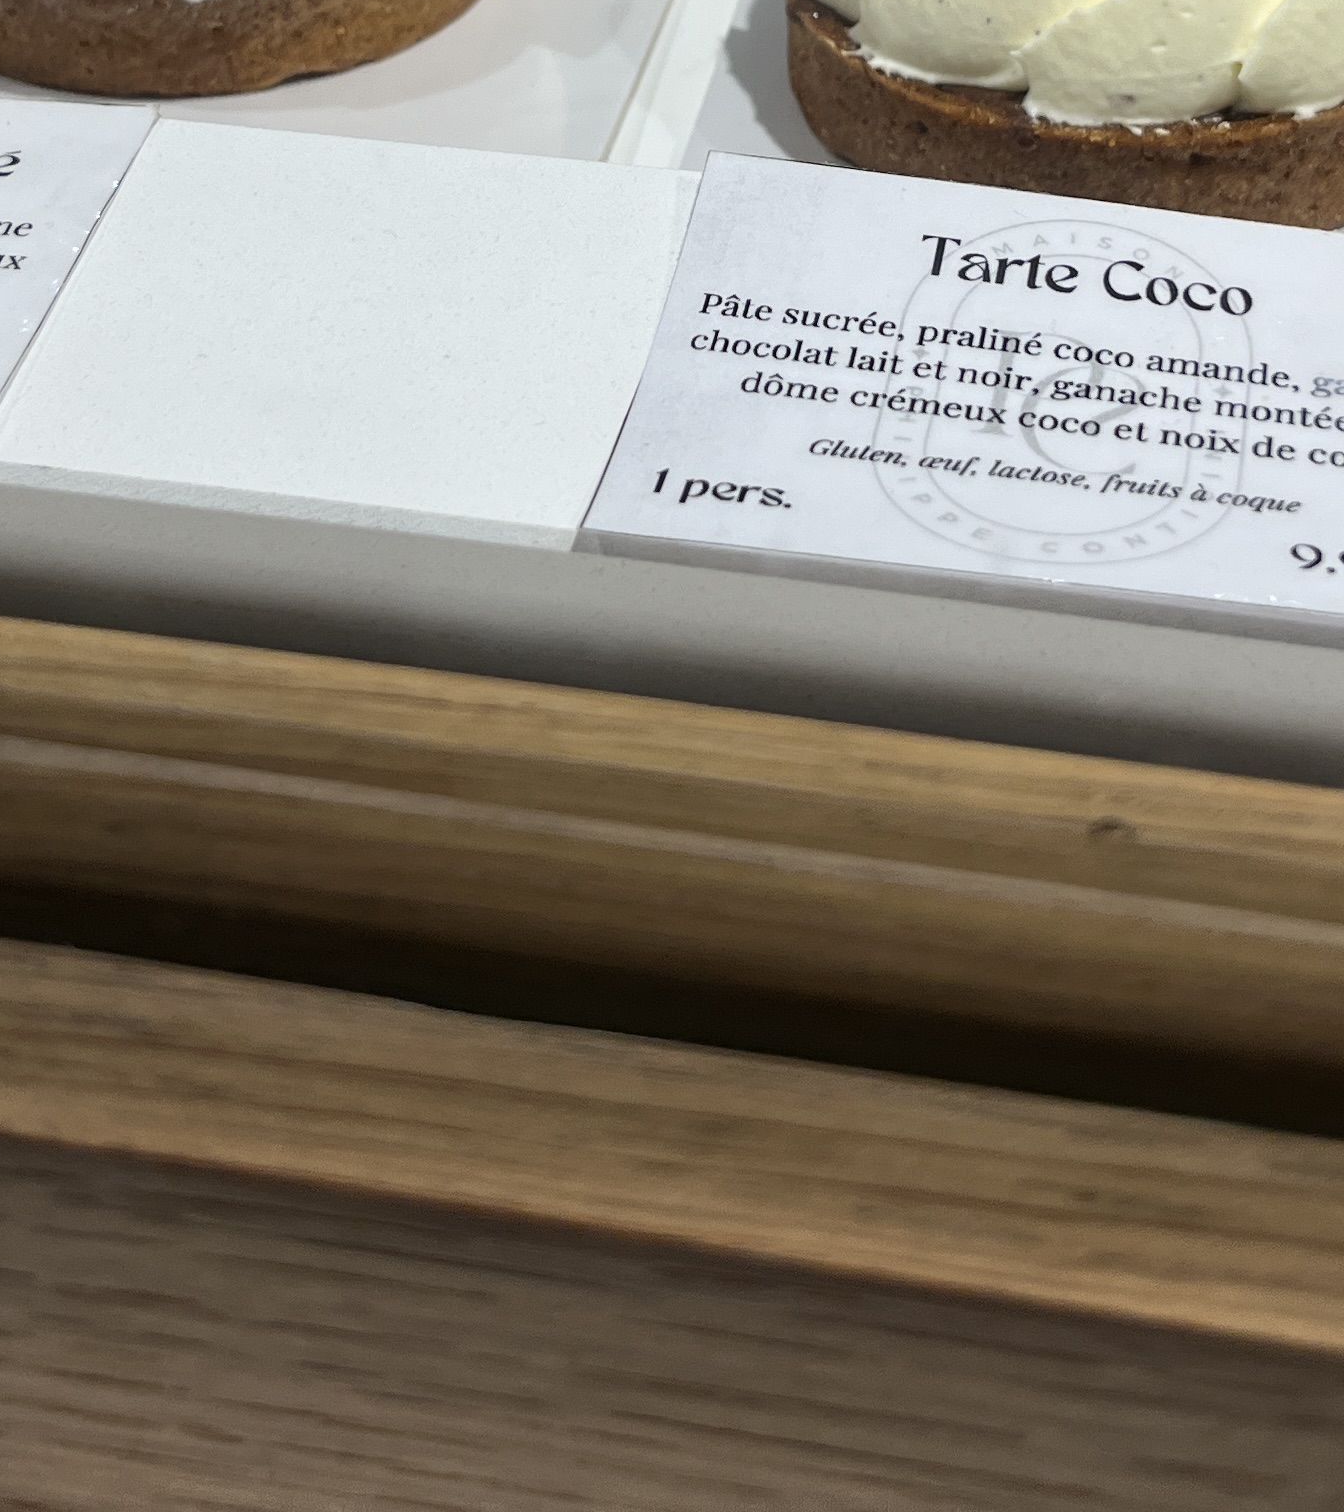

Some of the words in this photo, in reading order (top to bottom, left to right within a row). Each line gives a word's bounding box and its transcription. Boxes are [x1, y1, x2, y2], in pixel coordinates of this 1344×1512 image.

[921, 233, 1080, 294] Tarte
[1102, 259, 1254, 317] Coco
[690, 328, 840, 368] chocolat
[845, 345, 905, 378] lait
[911, 351, 948, 383] et
[955, 363, 1047, 400] noir,
[1046, 370, 1203, 416] ganache
[698, 292, 773, 322] Pâte
[781, 307, 905, 343] sucrée,
[914, 325, 1043, 359] praliné
[1052, 337, 1135, 370] coco
[1145, 354, 1301, 394] amande,
[740, 370, 840, 404] dôme
[849, 386, 1008, 429] crémeux
[1017, 402, 1110, 438] coco
[1110, 412, 1149, 444] et
[1158, 428, 1242, 455] noix
[1251, 434, 1297, 462] de
[652, 467, 670, 495] 1
[677, 478, 793, 510] pers.
[808, 438, 908, 468] Gluten,
[987, 459, 1091, 491] lactose,
[1098, 469, 1184, 500] fruits
[1189, 482, 1210, 503] à
[1215, 492, 1304, 514] coque
